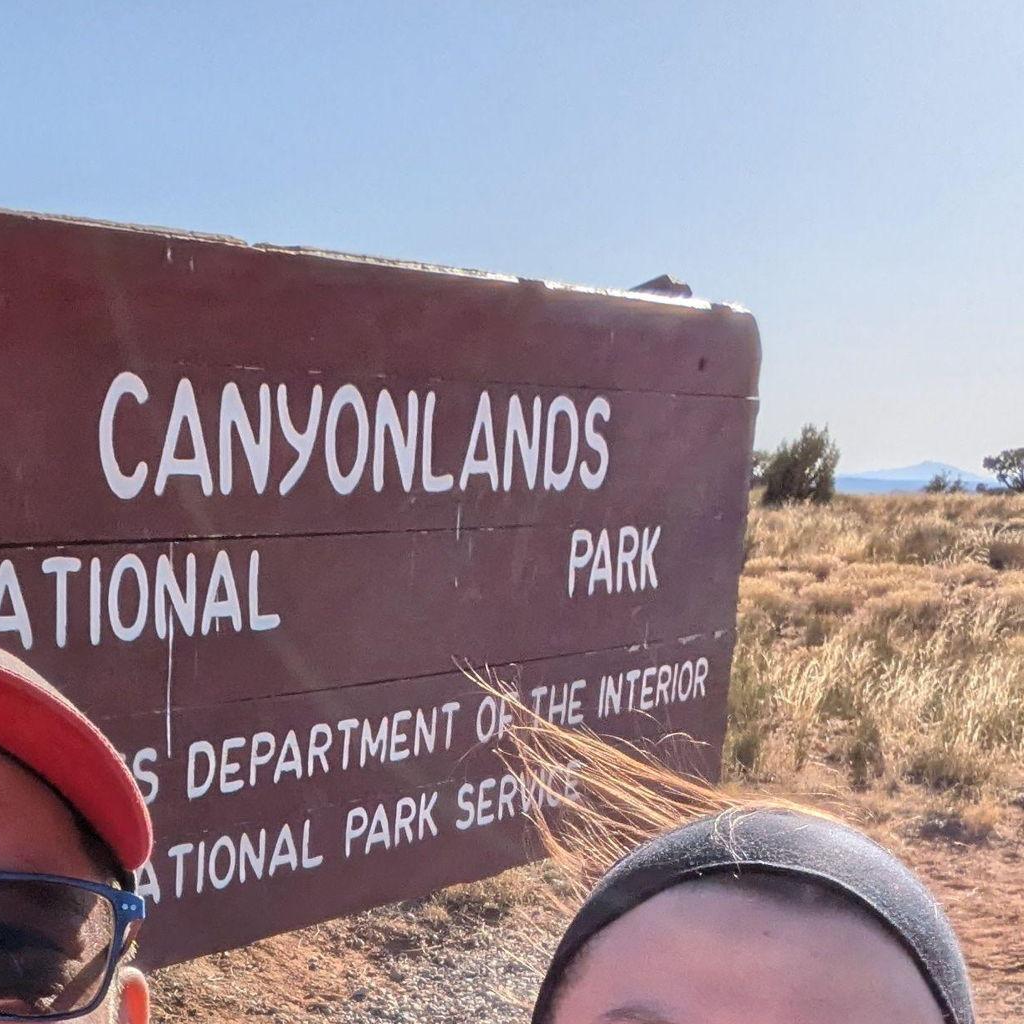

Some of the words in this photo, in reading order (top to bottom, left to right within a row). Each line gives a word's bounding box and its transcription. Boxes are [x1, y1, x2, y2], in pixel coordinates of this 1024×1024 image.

[99, 371, 611, 500] CANYONLANDS
[568, 525, 661, 598] PARK
[118, 748, 159, 804] S
[187, 700, 461, 800] DEPARTMENT
[476, 691, 519, 743] OF
[531, 679, 587, 732] THE
[598, 656, 709, 719] INTERIOR
[134, 819, 323, 904] ATIONAL
[345, 791, 437, 858] PARK
